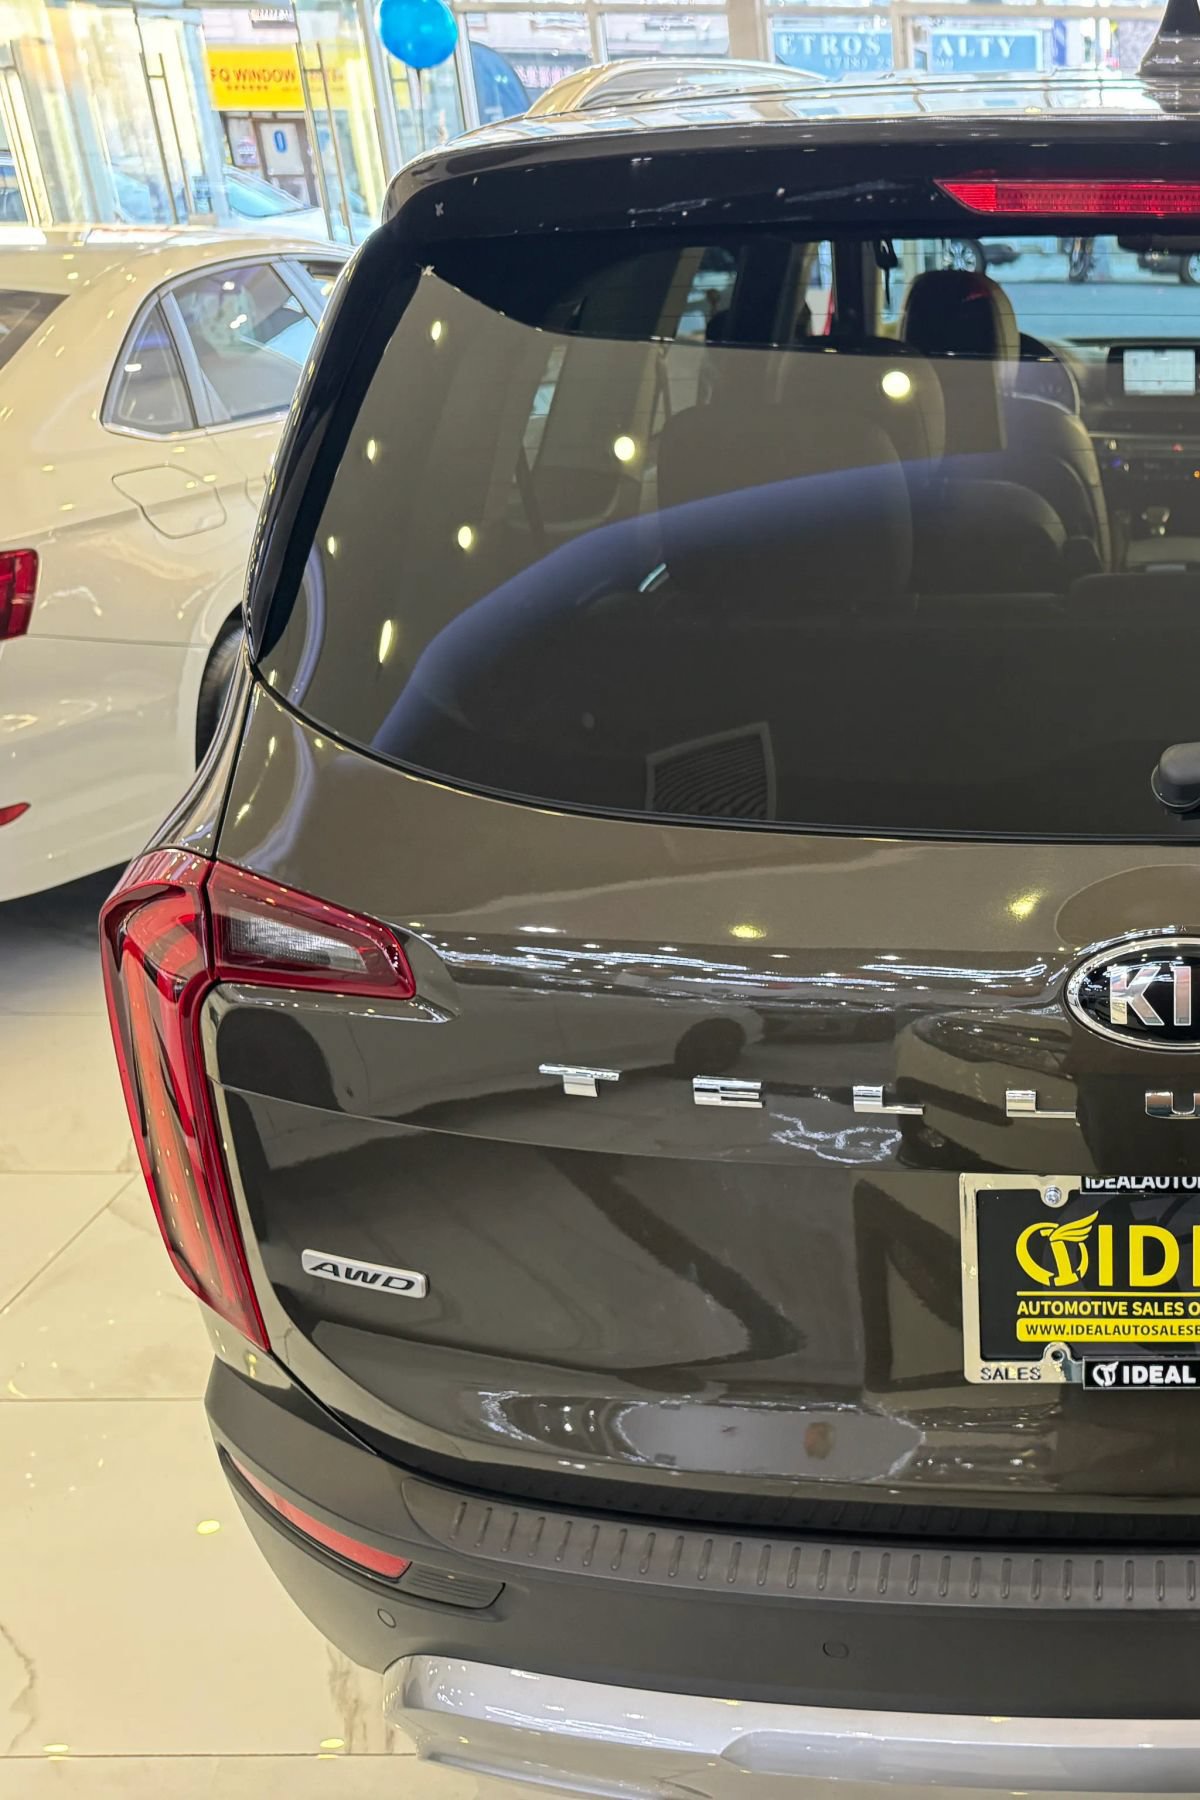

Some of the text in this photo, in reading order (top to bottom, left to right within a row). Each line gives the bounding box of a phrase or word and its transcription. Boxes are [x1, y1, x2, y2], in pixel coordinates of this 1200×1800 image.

[233, 68, 296, 82] WINDOW
[309, 1262, 416, 1291] AWD
[1016, 1301, 1129, 1316] AUTOMOTIVE
[1132, 1302, 1184, 1316] SALES
[980, 1366, 1041, 1381] SALES
[1123, 1365, 1196, 1385] IDEAL
